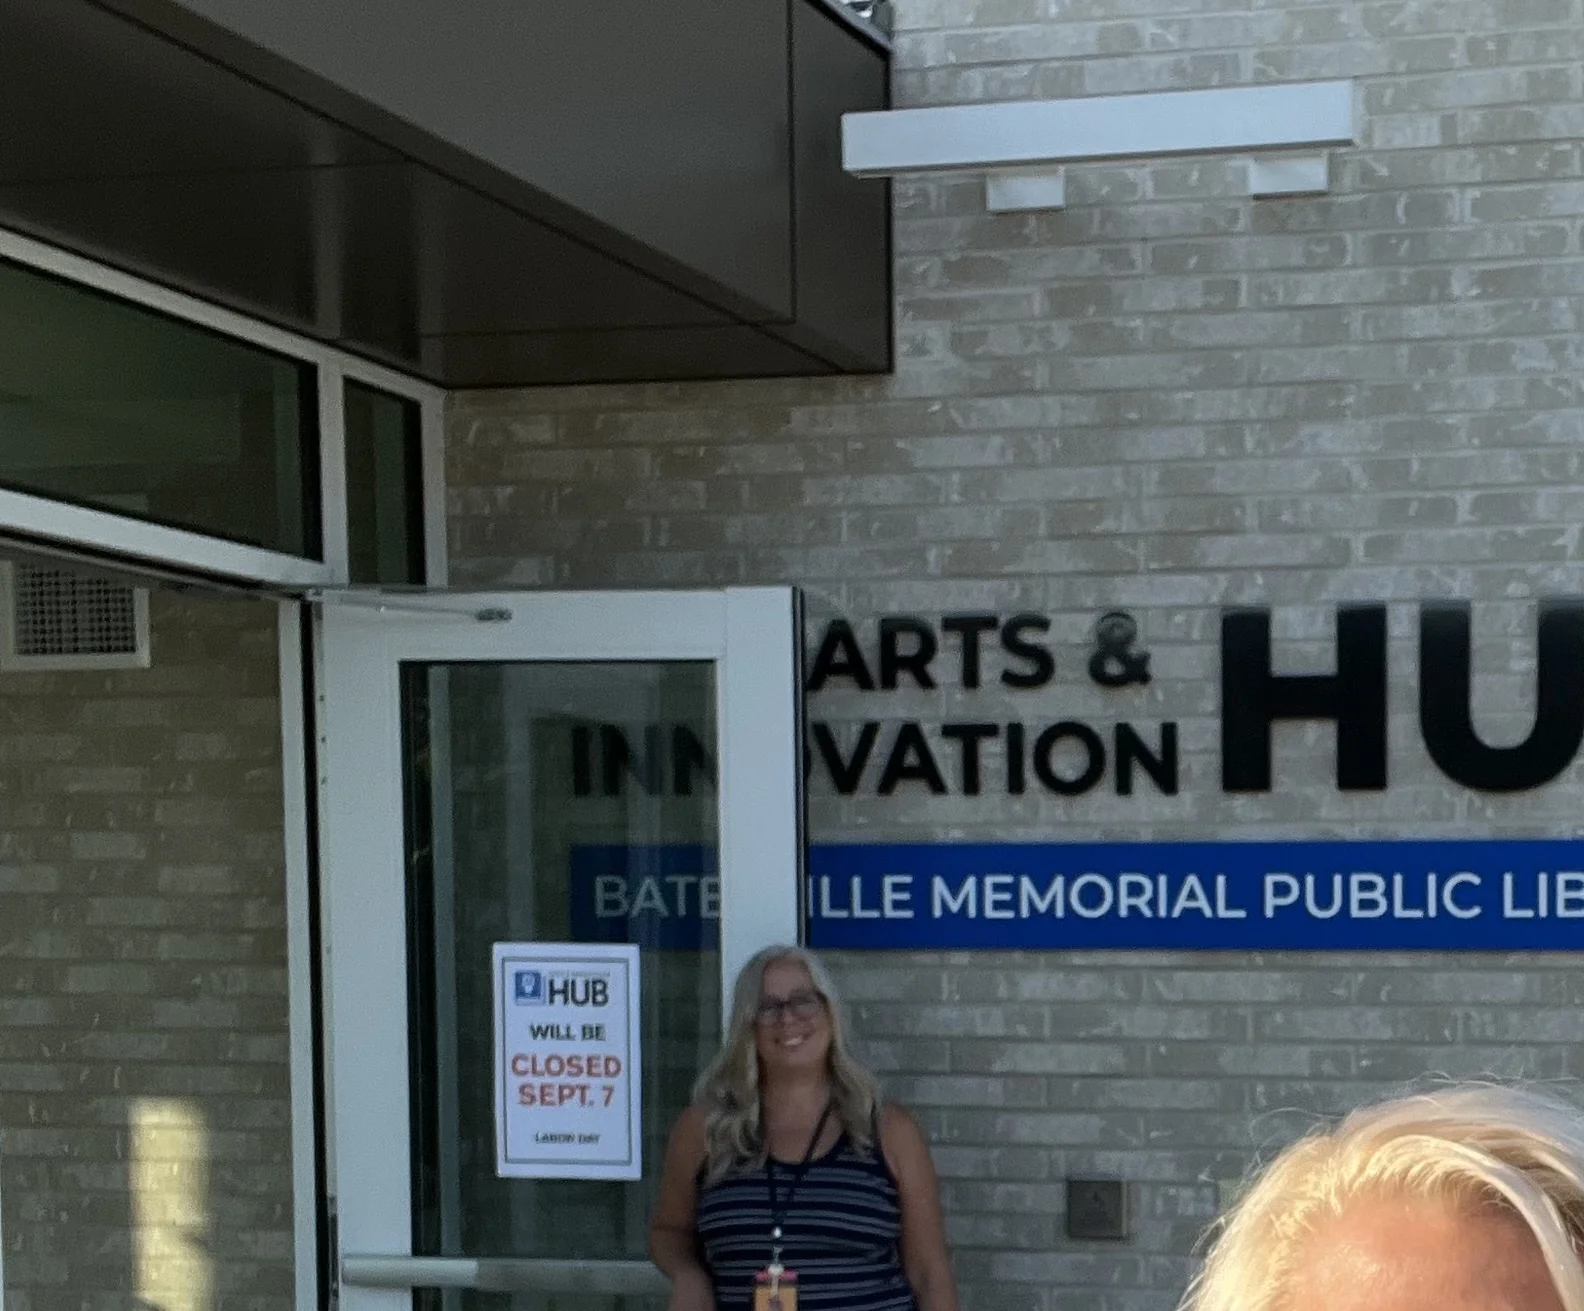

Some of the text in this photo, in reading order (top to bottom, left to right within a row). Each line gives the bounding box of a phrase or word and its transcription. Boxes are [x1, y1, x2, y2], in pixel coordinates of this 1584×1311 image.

[807, 611, 1151, 691] ARTS &
[571, 721, 1179, 797] INNVATION
[594, 873, 913, 920] BATEILLE
[931, 871, 1247, 920] MEMORIAL
[1263, 871, 1483, 920] PUBLIC
[548, 978, 609, 1007] HUB
[530, 1023, 607, 1042] WILL BE
[511, 1053, 623, 1079] CLOSED
[518, 1083, 616, 1108] SEPT. 7
